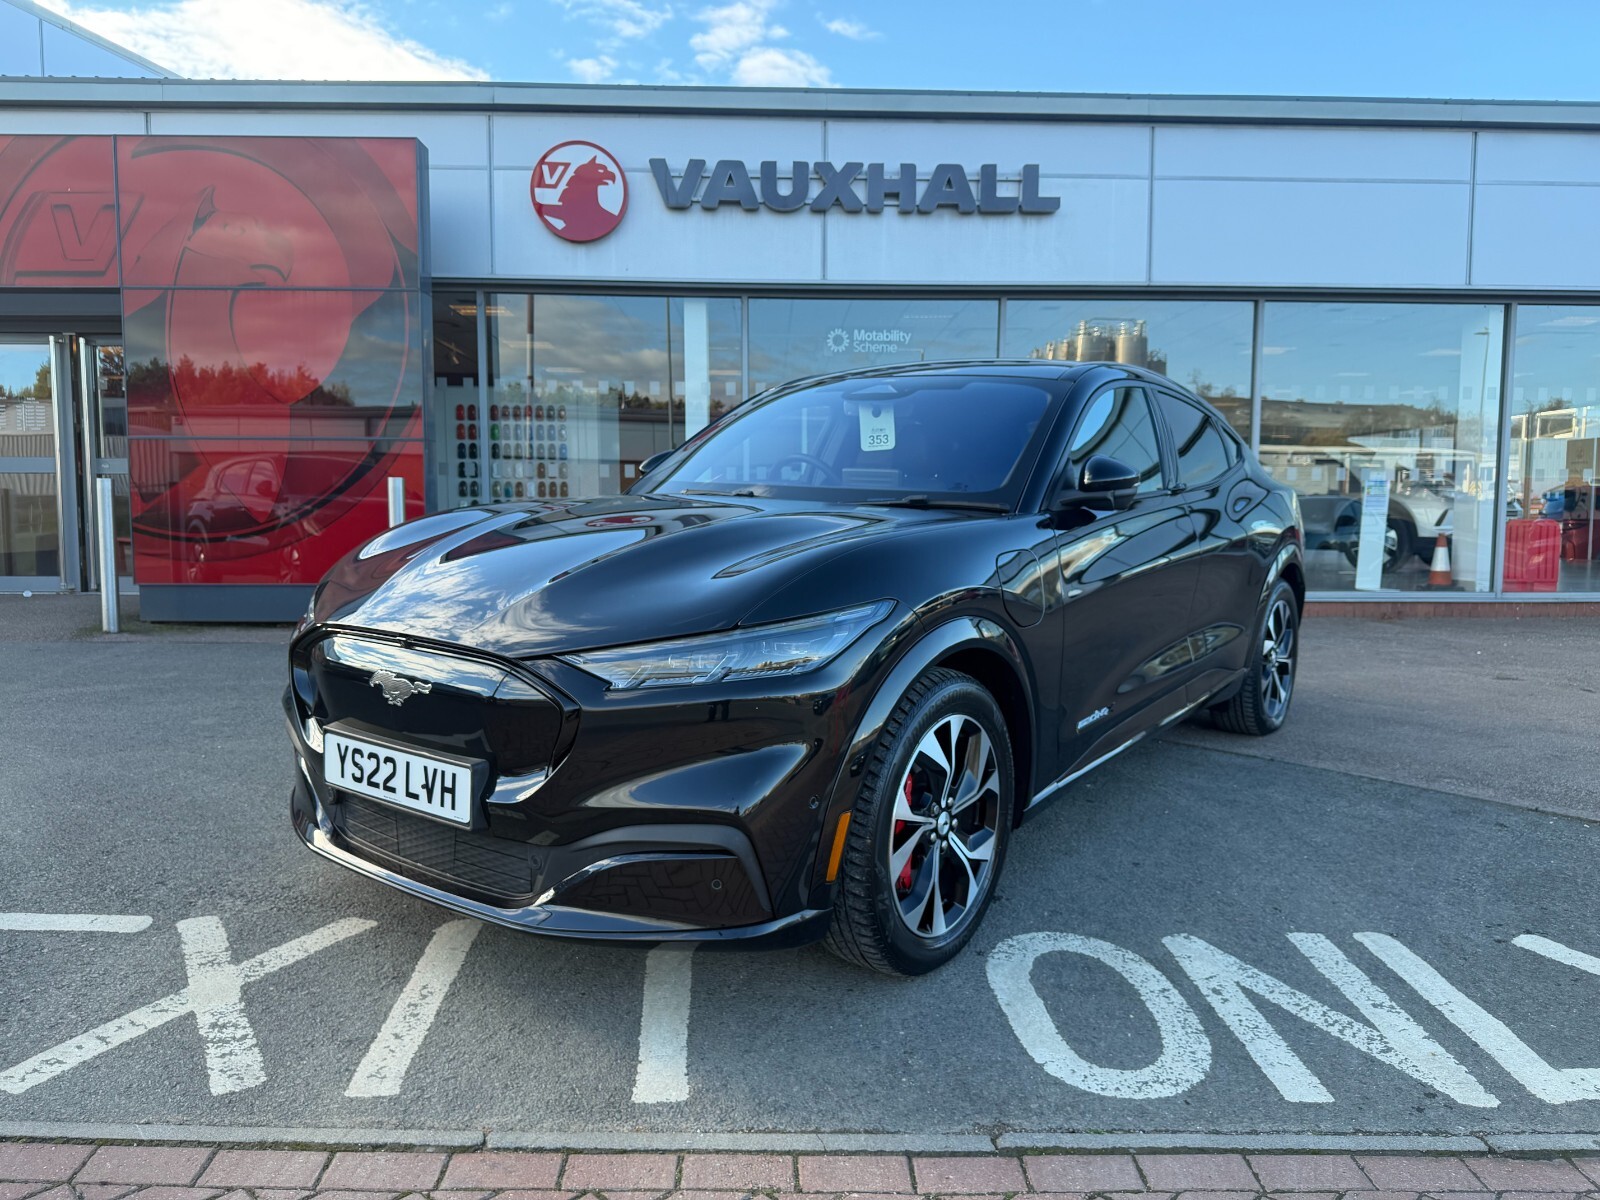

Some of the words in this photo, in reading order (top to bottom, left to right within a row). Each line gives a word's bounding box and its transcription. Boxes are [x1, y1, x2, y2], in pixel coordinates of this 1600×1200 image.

[541, 164, 565, 185] V
[650, 158, 1060, 214] VAUXHALL
[853, 329, 911, 344] Motability
[853, 341, 898, 353] Scheme
[868, 434, 889, 445] 353
[337, 743, 396, 794] YS22
[406, 761, 457, 811] LVH
[0, 912, 692, 1106] XIT
[985, 931, 1600, 1107] ONL
